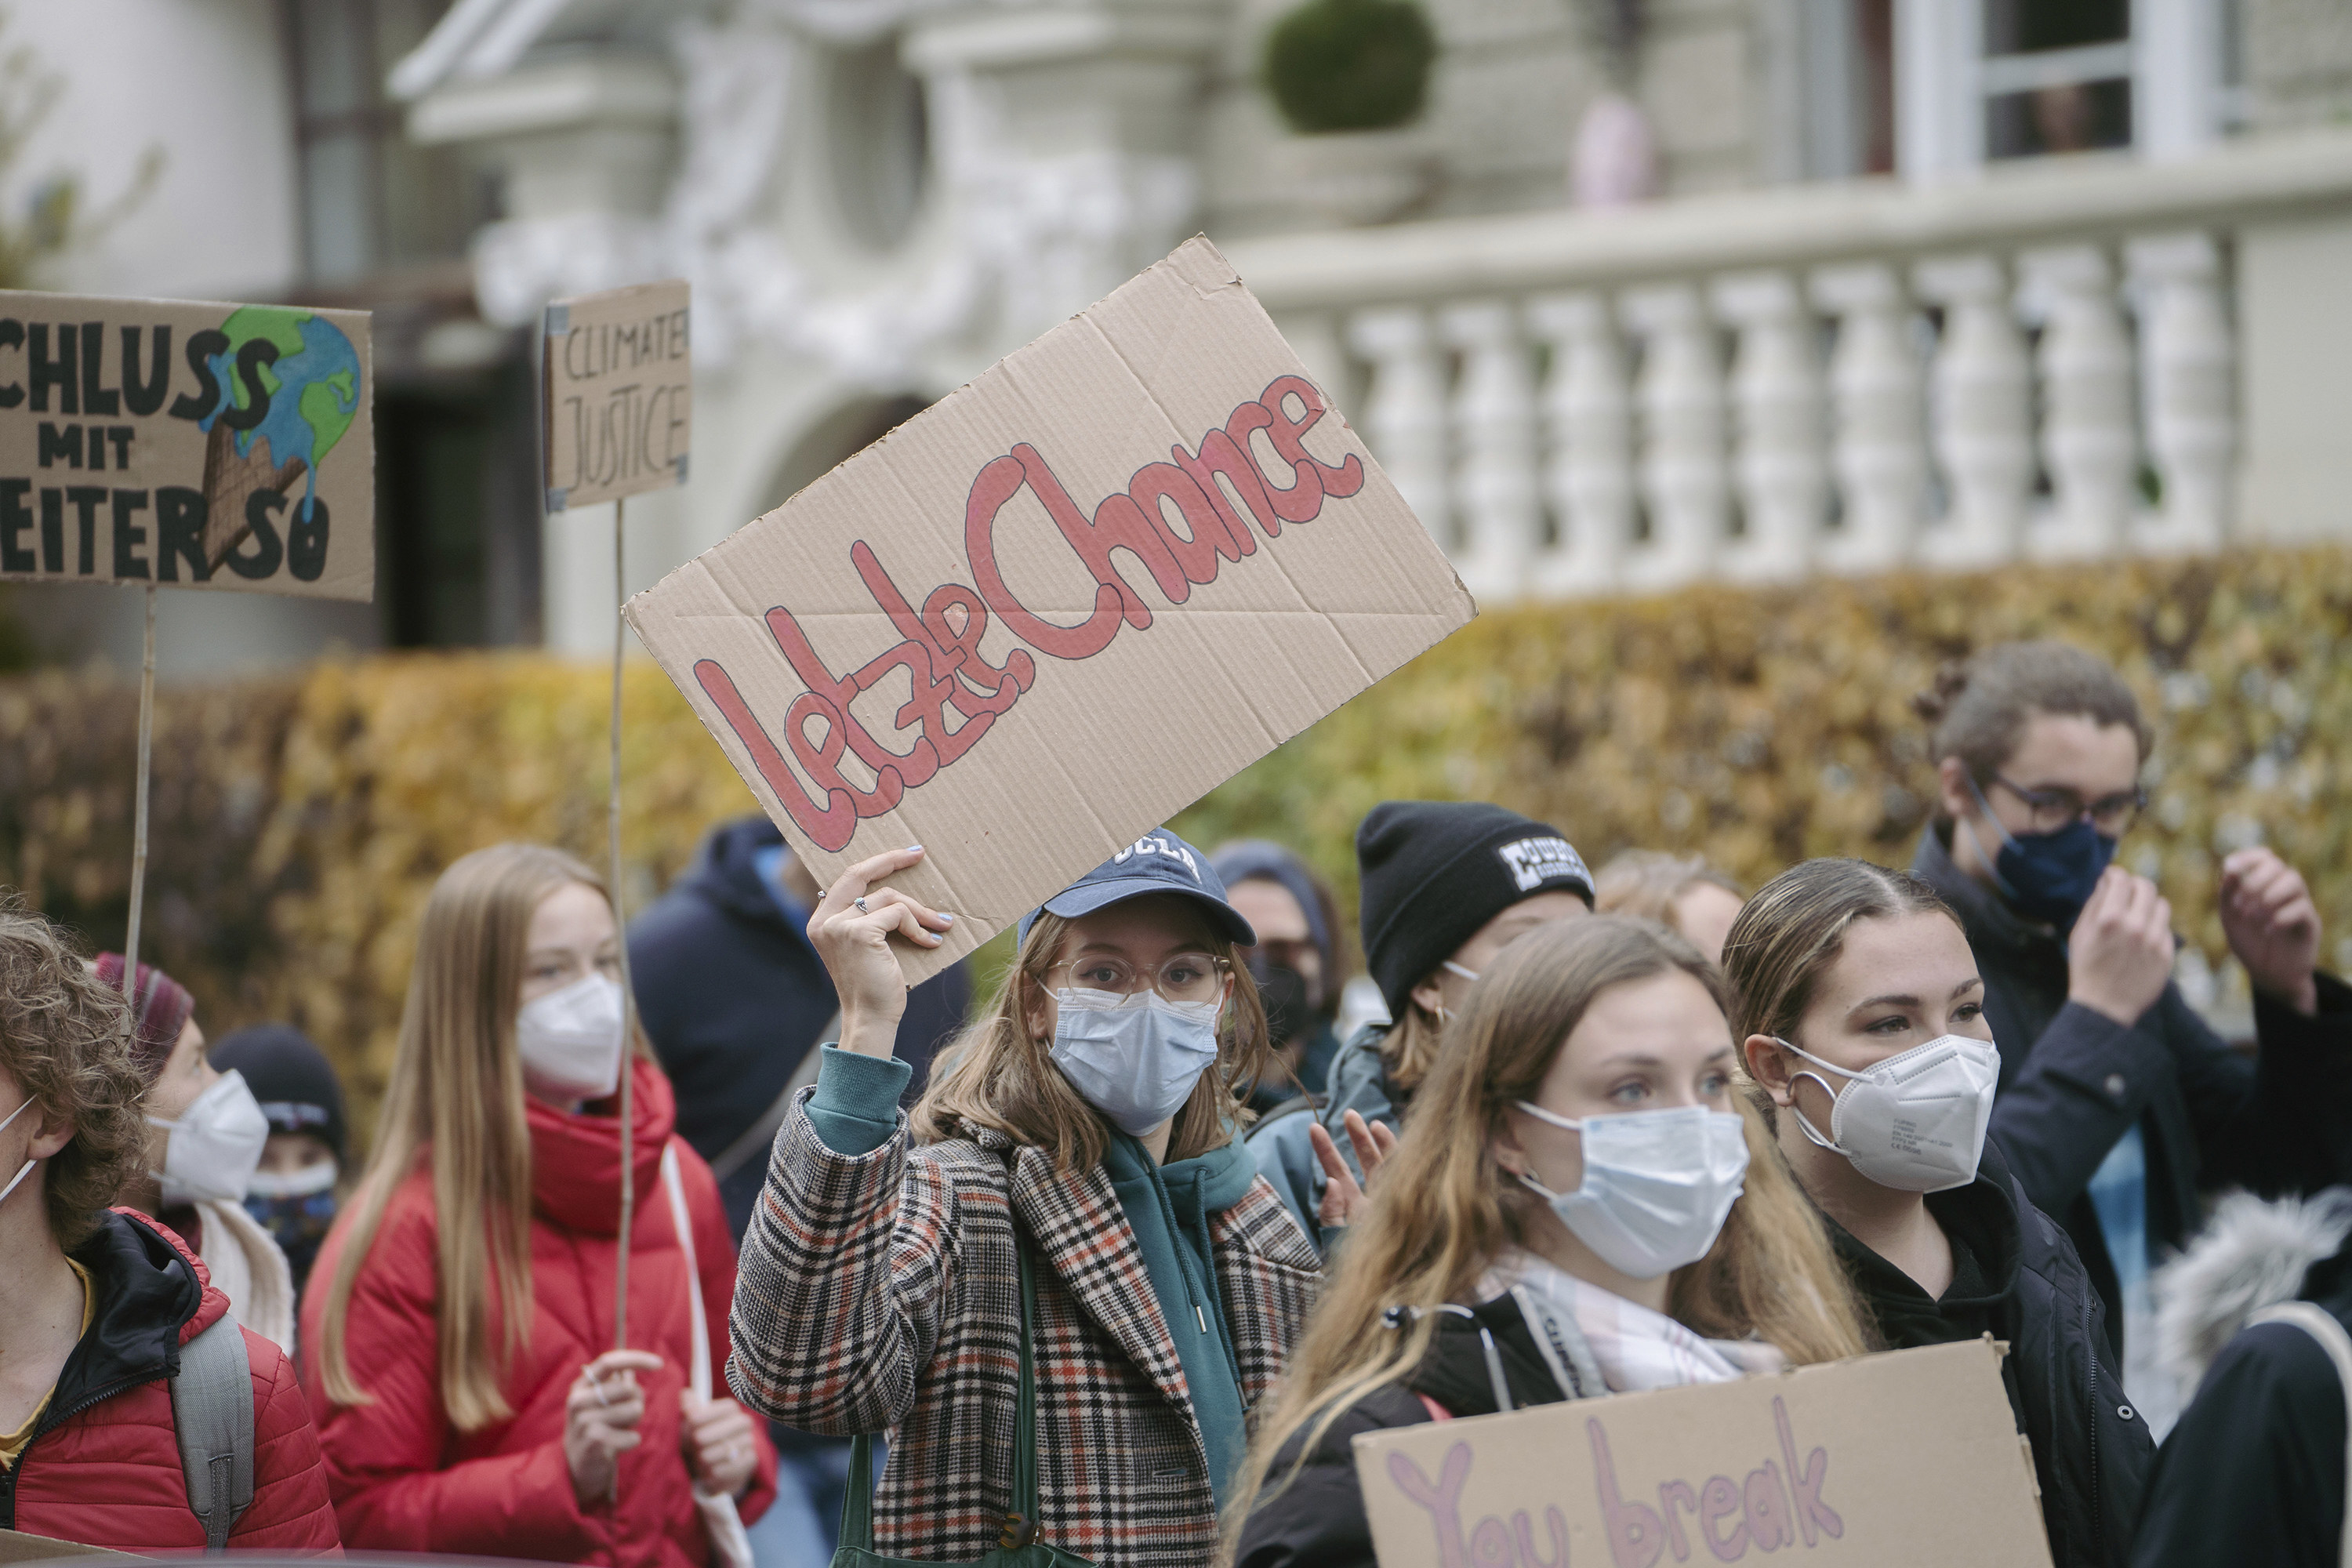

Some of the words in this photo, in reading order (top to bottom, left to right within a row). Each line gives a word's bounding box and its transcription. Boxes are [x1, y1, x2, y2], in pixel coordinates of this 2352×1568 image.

[564, 309, 688, 380] CLIMATE
[38, 422, 135, 470] MIT
[564, 383, 687, 492] JUSTICE
[226, 488, 330, 582] SO
[965, 375, 1364, 660] Chance
[1385, 1438, 1570, 1568] You
[1585, 1395, 1844, 1568] break
